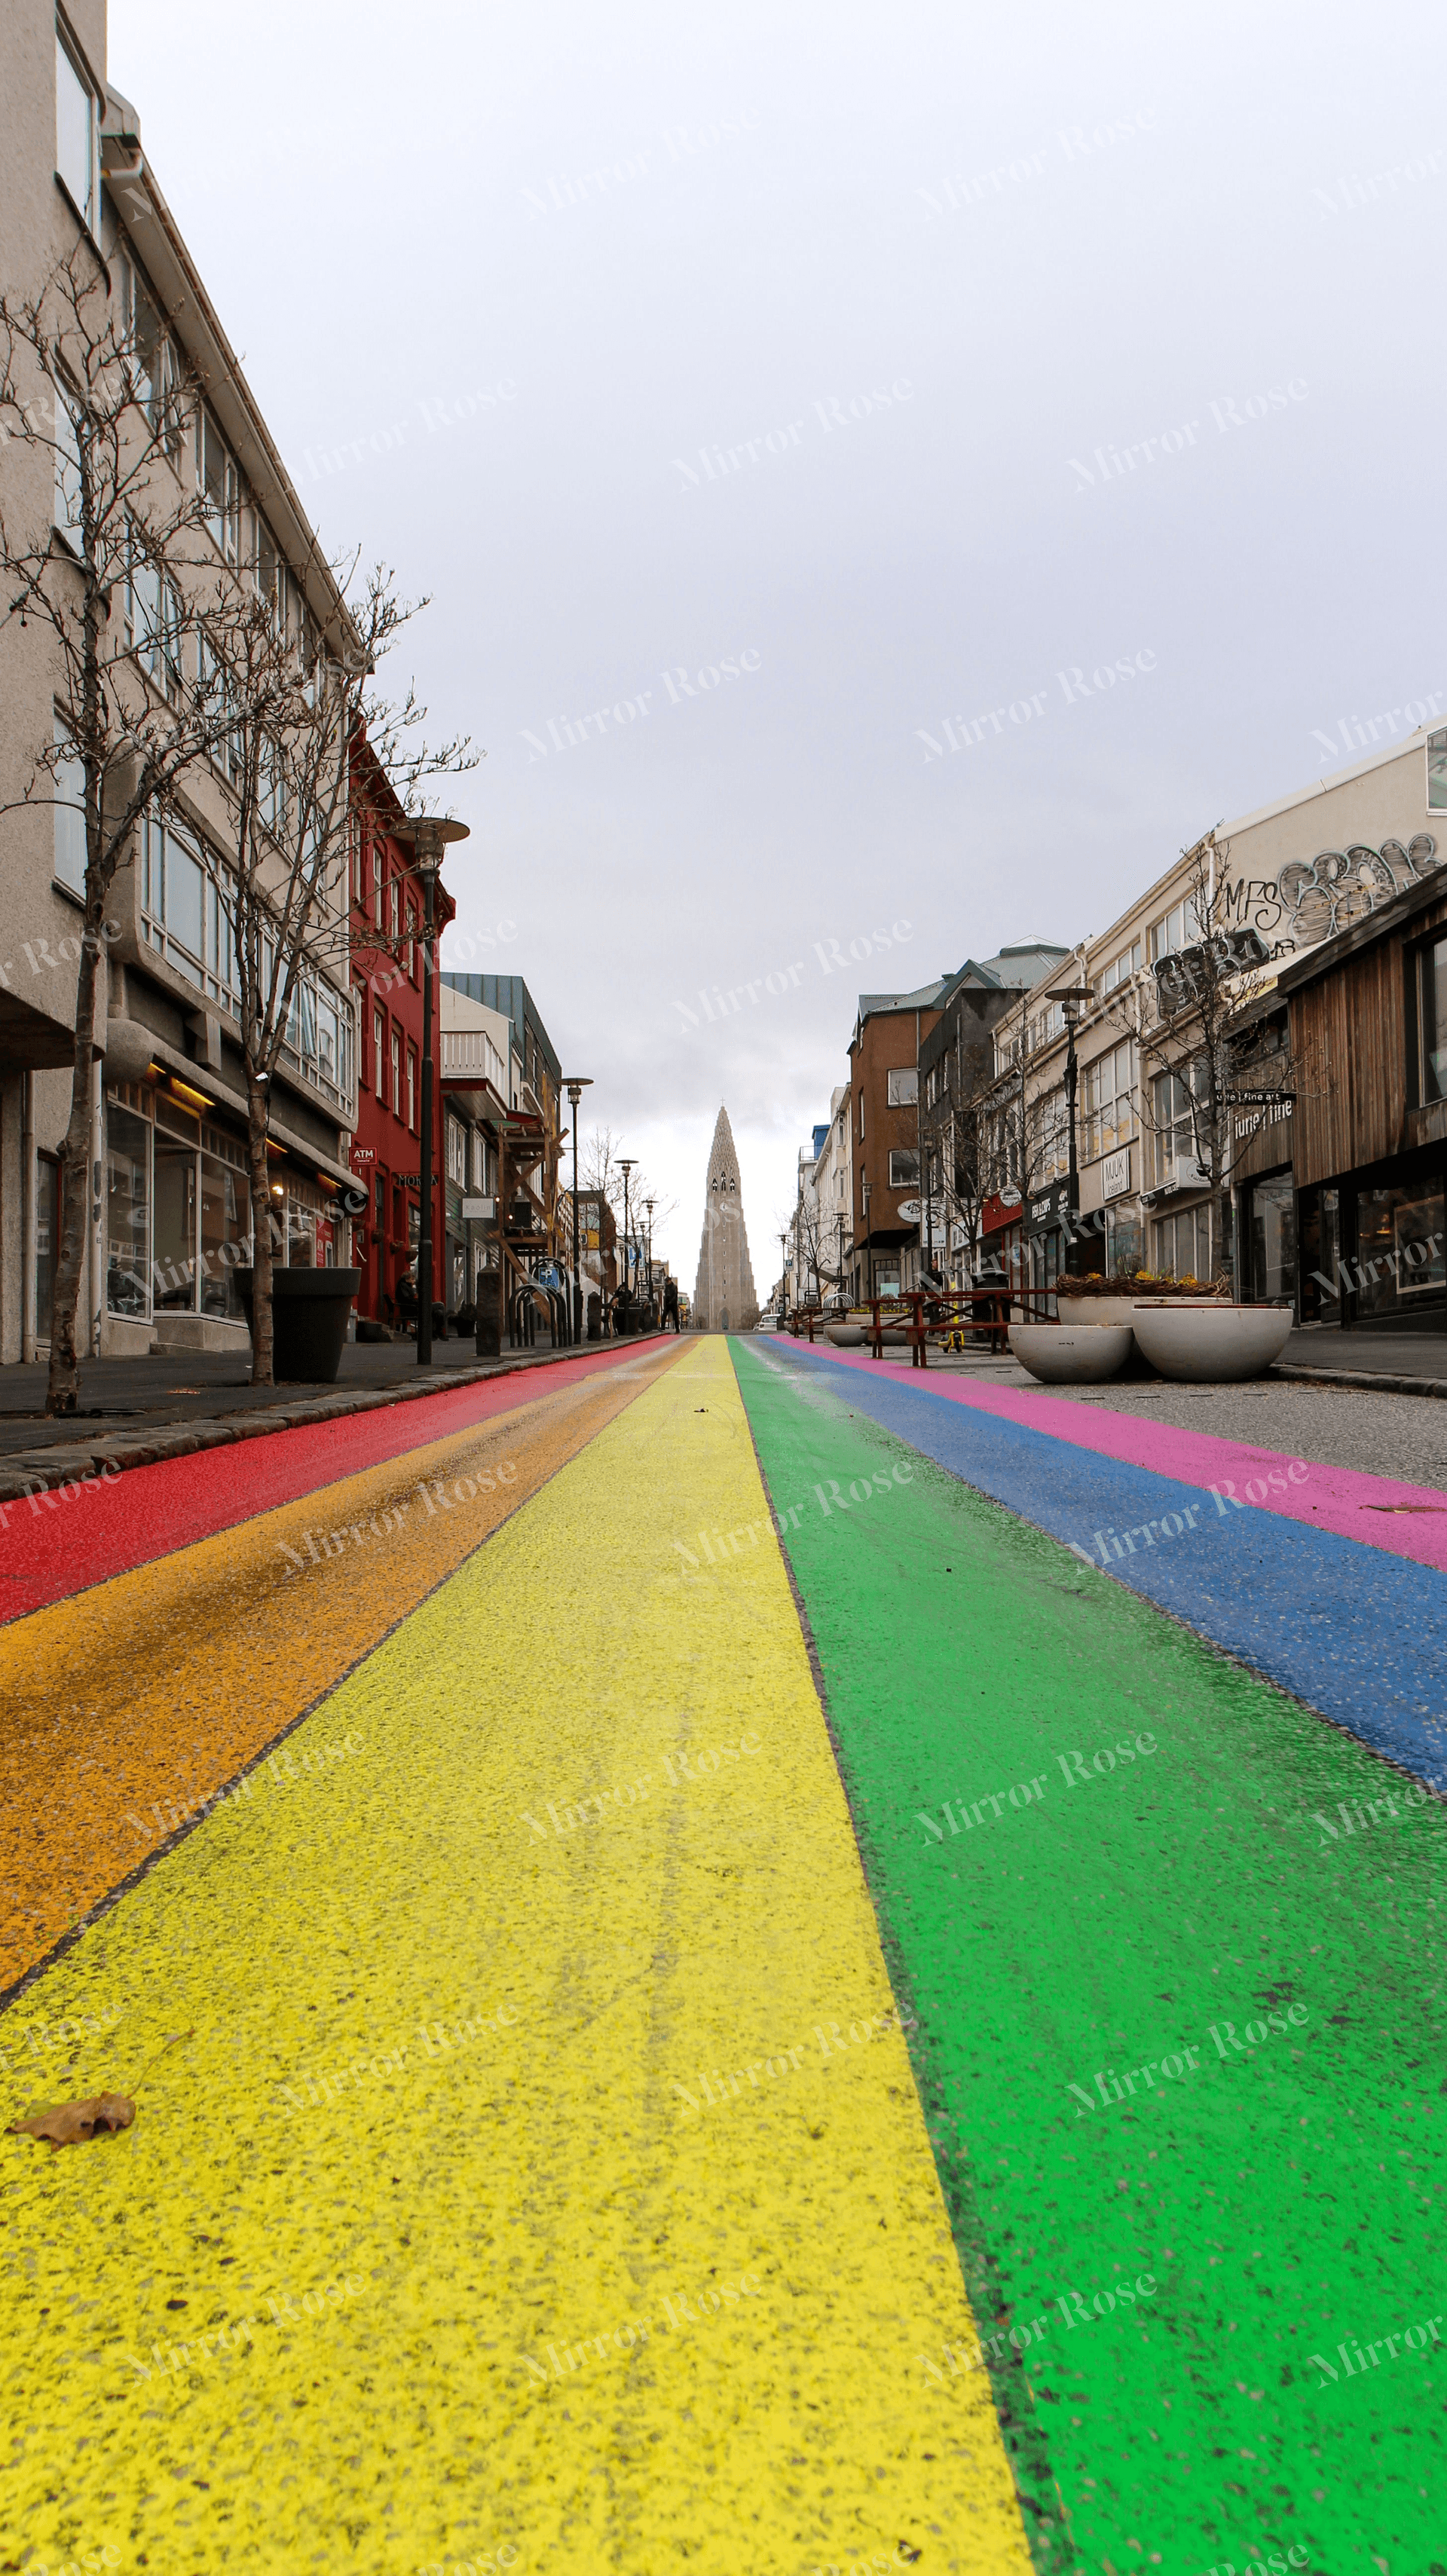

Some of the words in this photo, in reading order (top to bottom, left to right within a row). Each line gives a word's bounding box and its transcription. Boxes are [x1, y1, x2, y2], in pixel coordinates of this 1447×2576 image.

[1227, 879, 1281, 931] MFS
[1244, 1092, 1263, 1101] fine
[1235, 1112, 1259, 1140] iurie
[1269, 1100, 1292, 1124] fine
[353, 1149, 373, 1158] ATM
[1106, 1155, 1124, 1182] MJÚK
[399, 1175, 438, 1186] MOKA
[1107, 1180, 1123, 1197] Iceland
